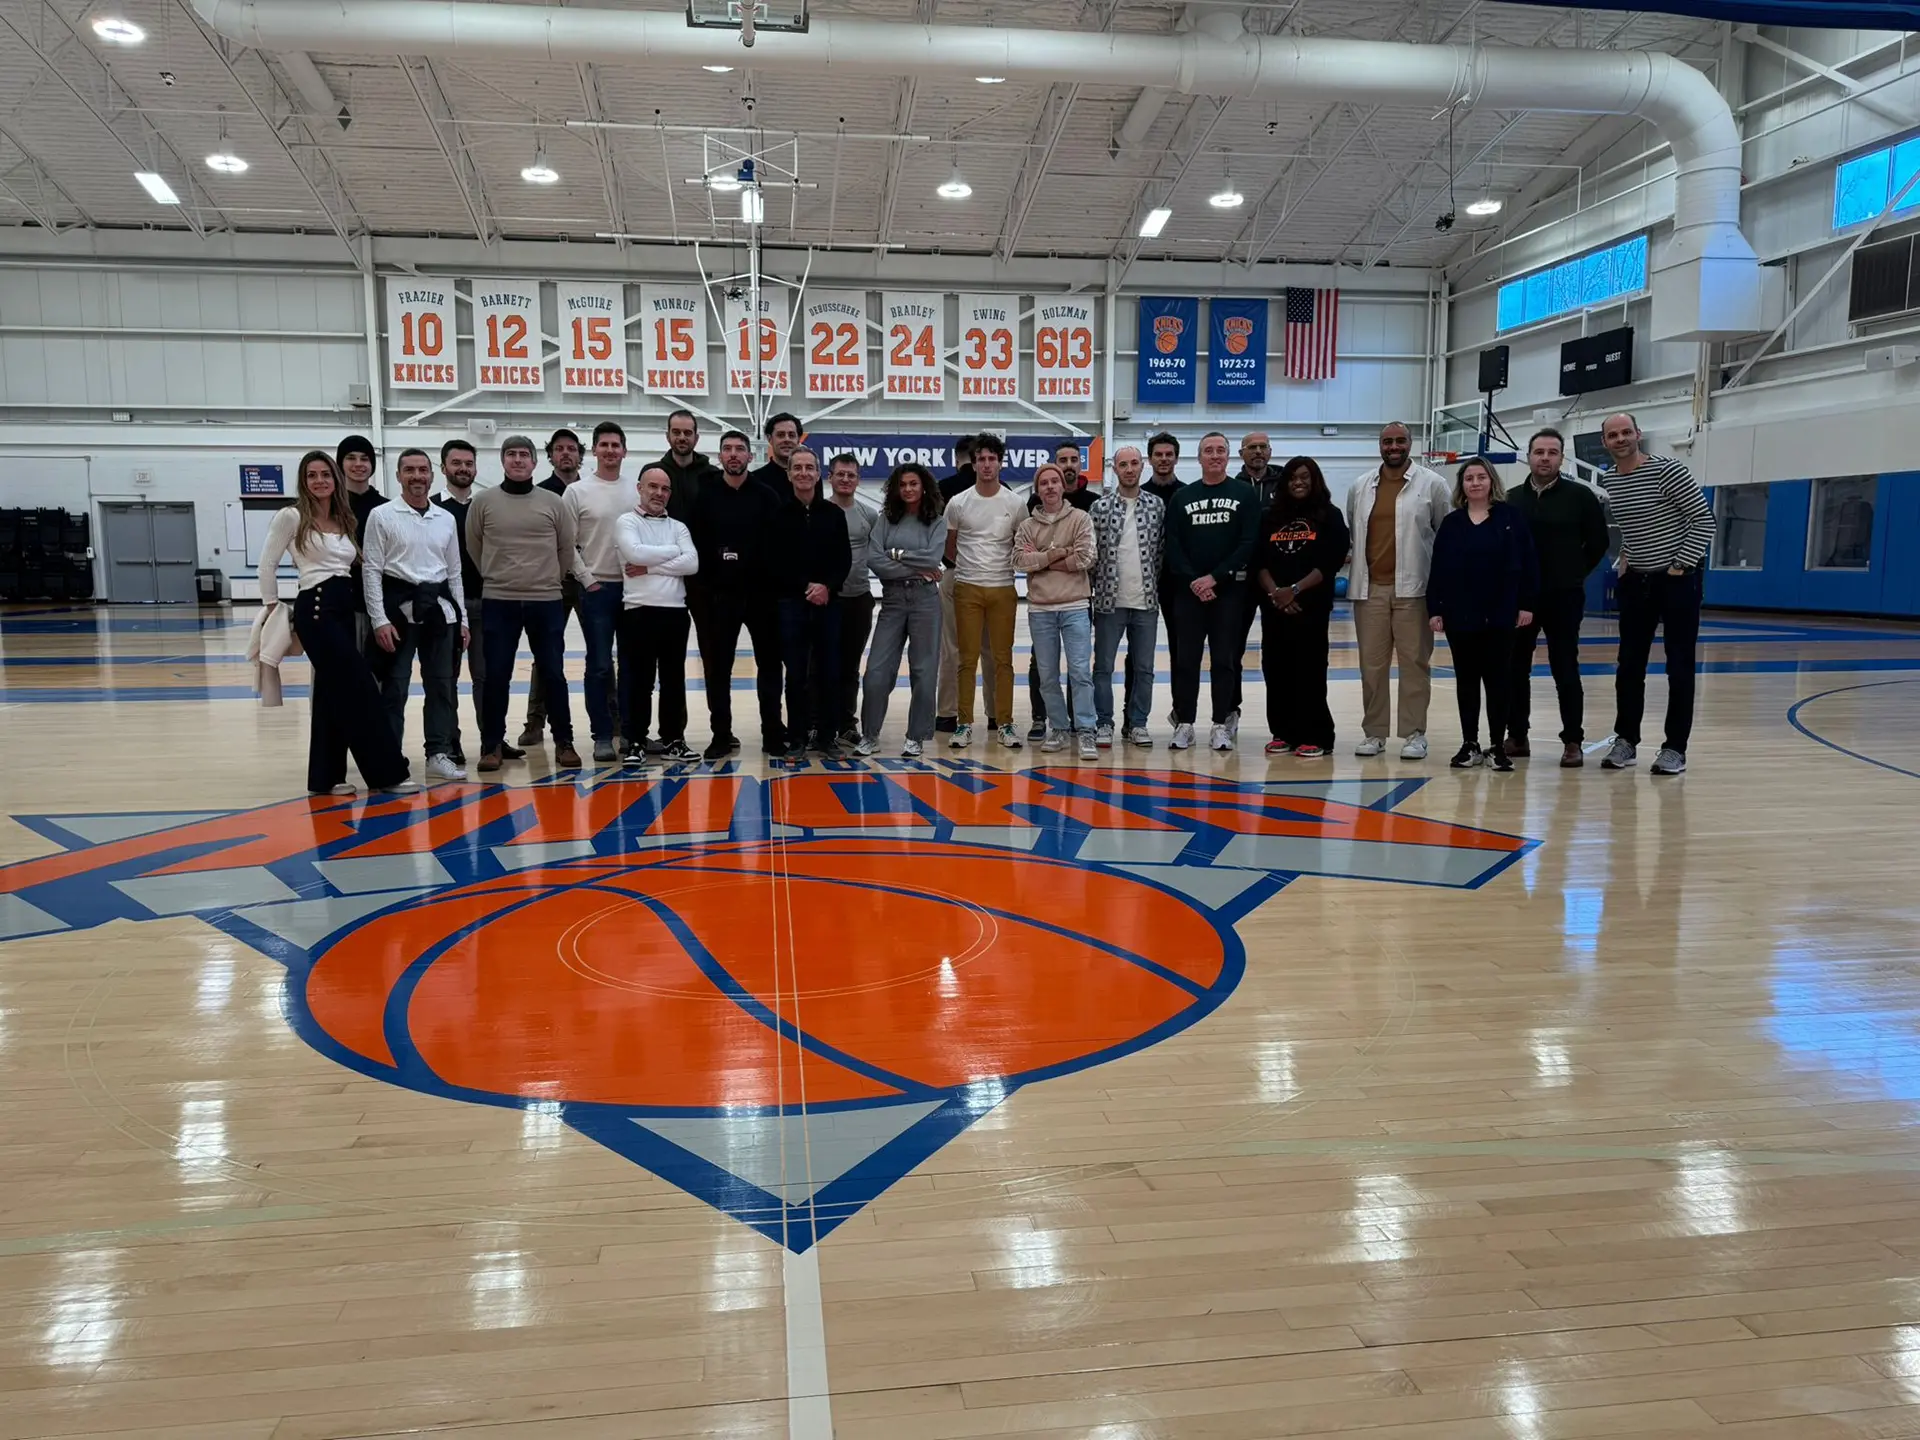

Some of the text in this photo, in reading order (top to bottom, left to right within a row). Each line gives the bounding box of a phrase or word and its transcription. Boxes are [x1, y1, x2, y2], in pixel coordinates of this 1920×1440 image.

[398, 290, 445, 306] FRAZIER
[480, 294, 532, 309] BARNETT
[567, 298, 613, 311] McGUIRE
[653, 299, 696, 312] MONROE
[744, 300, 770, 311] RED
[808, 303, 860, 318] DEBUSSCHERE
[890, 305, 936, 319] BRADLEY
[973, 308, 1006, 321] EWING
[1042, 307, 1088, 320] HOLZMAN
[401, 312, 443, 356] 10
[486, 314, 528, 358] 12
[572, 316, 612, 360] 15
[654, 318, 694, 361] 15
[738, 317, 777, 361] 19
[810, 322, 859, 366] 22
[890, 324, 936, 367] 24
[965, 327, 1013, 370] 33
[1036, 326, 1092, 369] 613
[1148, 358, 1186, 368] 1969-70
[1219, 358, 1256, 369] 1972-73
[1605, 351, 1622, 363] GUEST
[393, 363, 455, 384] KNICKS
[480, 365, 540, 386] KNICKS
[565, 367, 624, 387] KNICKS
[647, 369, 705, 389] KNICKS
[809, 373, 864, 392] KNICKS
[1147, 378, 1186, 386] CHAMPIONS
[1155, 371, 1178, 379] WORLD
[887, 375, 941, 394] KNICKS
[962, 377, 1016, 395] KNICKS
[1038, 378, 1091, 396] KNICKS
[883, 448, 946, 467] YORK
[952, 448, 1050, 468] EVER
[1184, 498, 1241, 515] NEW YORK
[1192, 511, 1230, 525] KNICKS
